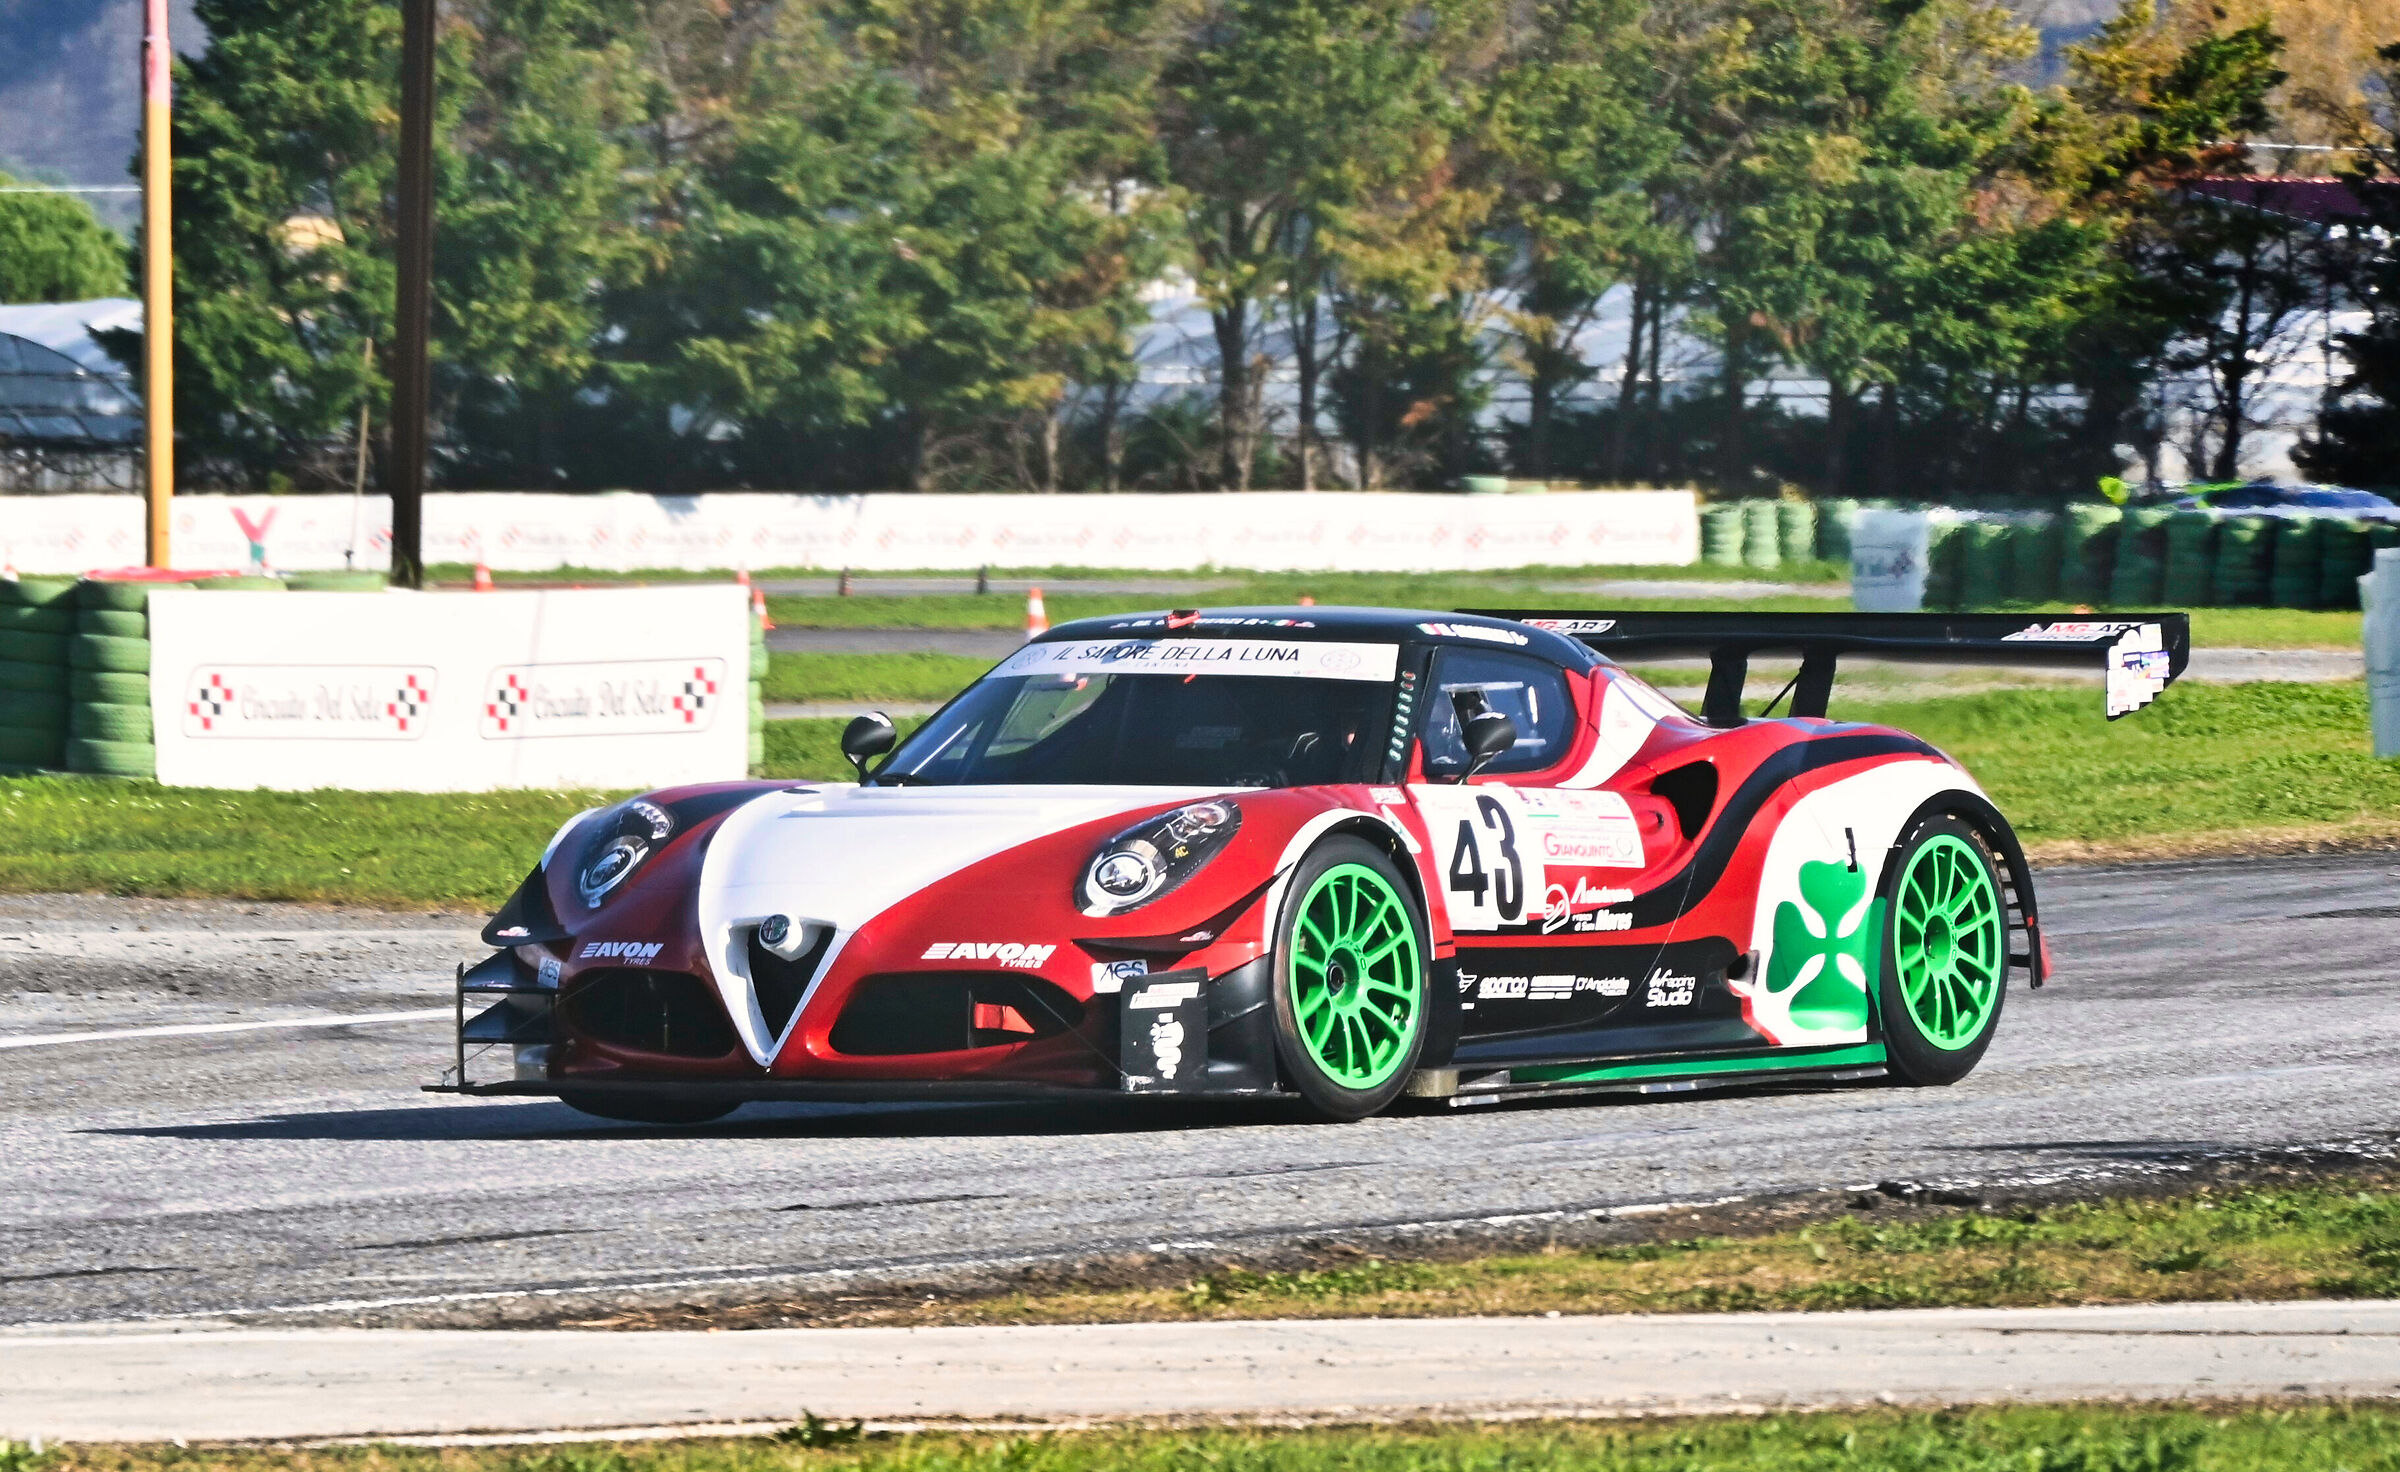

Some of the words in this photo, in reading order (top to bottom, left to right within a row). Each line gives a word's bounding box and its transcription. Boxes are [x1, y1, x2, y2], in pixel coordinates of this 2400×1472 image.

[1052, 647, 1071, 661] IL
[1076, 645, 1161, 661] SAPORE
[1161, 646, 1231, 661] DELLA
[1239, 647, 1300, 662] LUNA
[1449, 795, 1525, 921] 43
[595, 942, 664, 958] AVON
[948, 942, 1057, 961] AVON
[623, 957, 652, 966] TYRES
[1000, 959, 1045, 969] TYRES
[1645, 987, 1693, 1008] Studio
